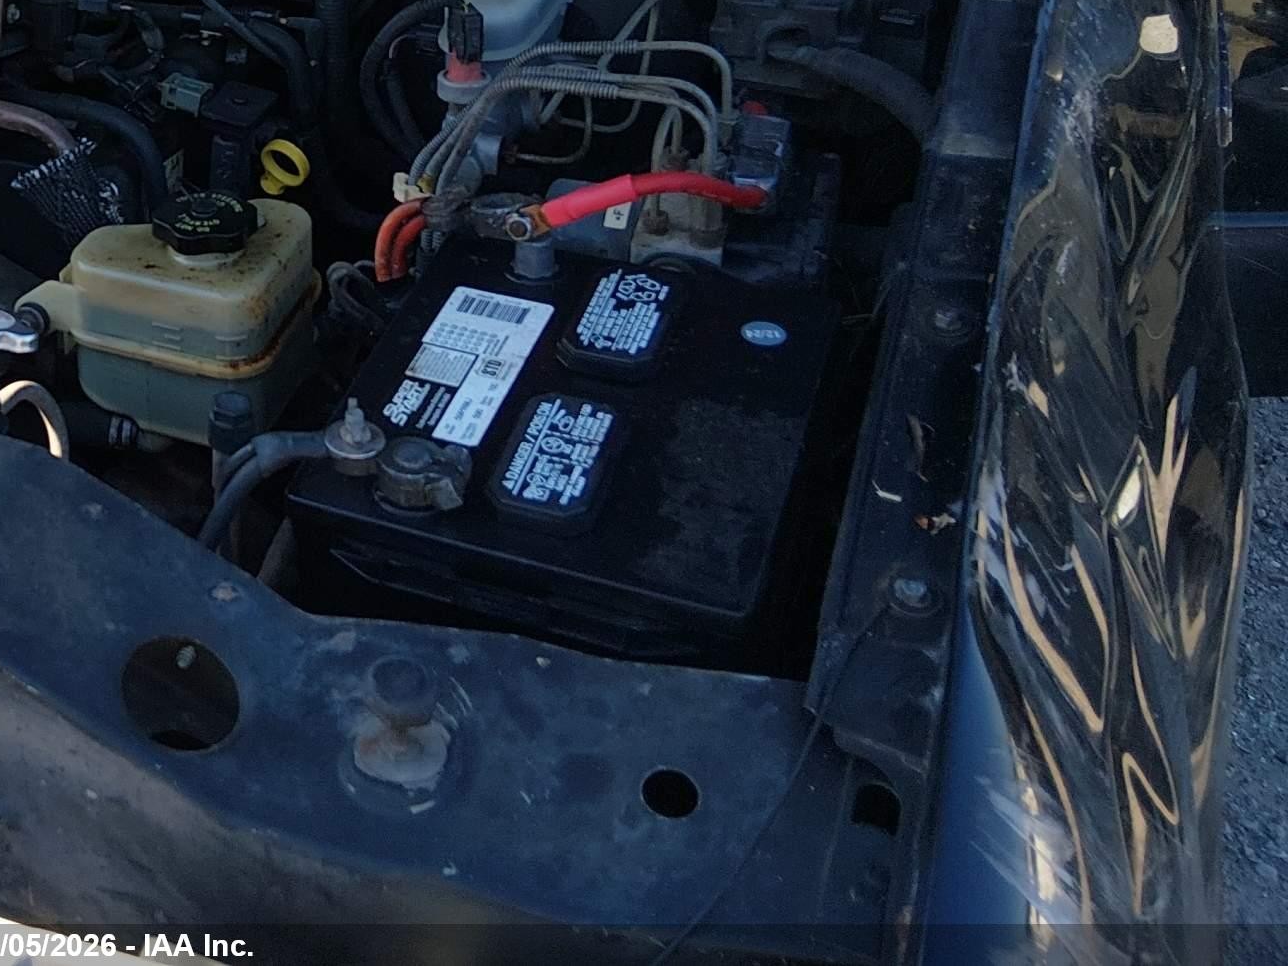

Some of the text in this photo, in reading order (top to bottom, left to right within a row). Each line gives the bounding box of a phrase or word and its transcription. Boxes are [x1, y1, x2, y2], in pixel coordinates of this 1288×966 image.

[383, 379, 414, 416] SUPER
[390, 382, 423, 426] START
[505, 441, 534, 480] DANGER
[526, 401, 553, 436] POISON
